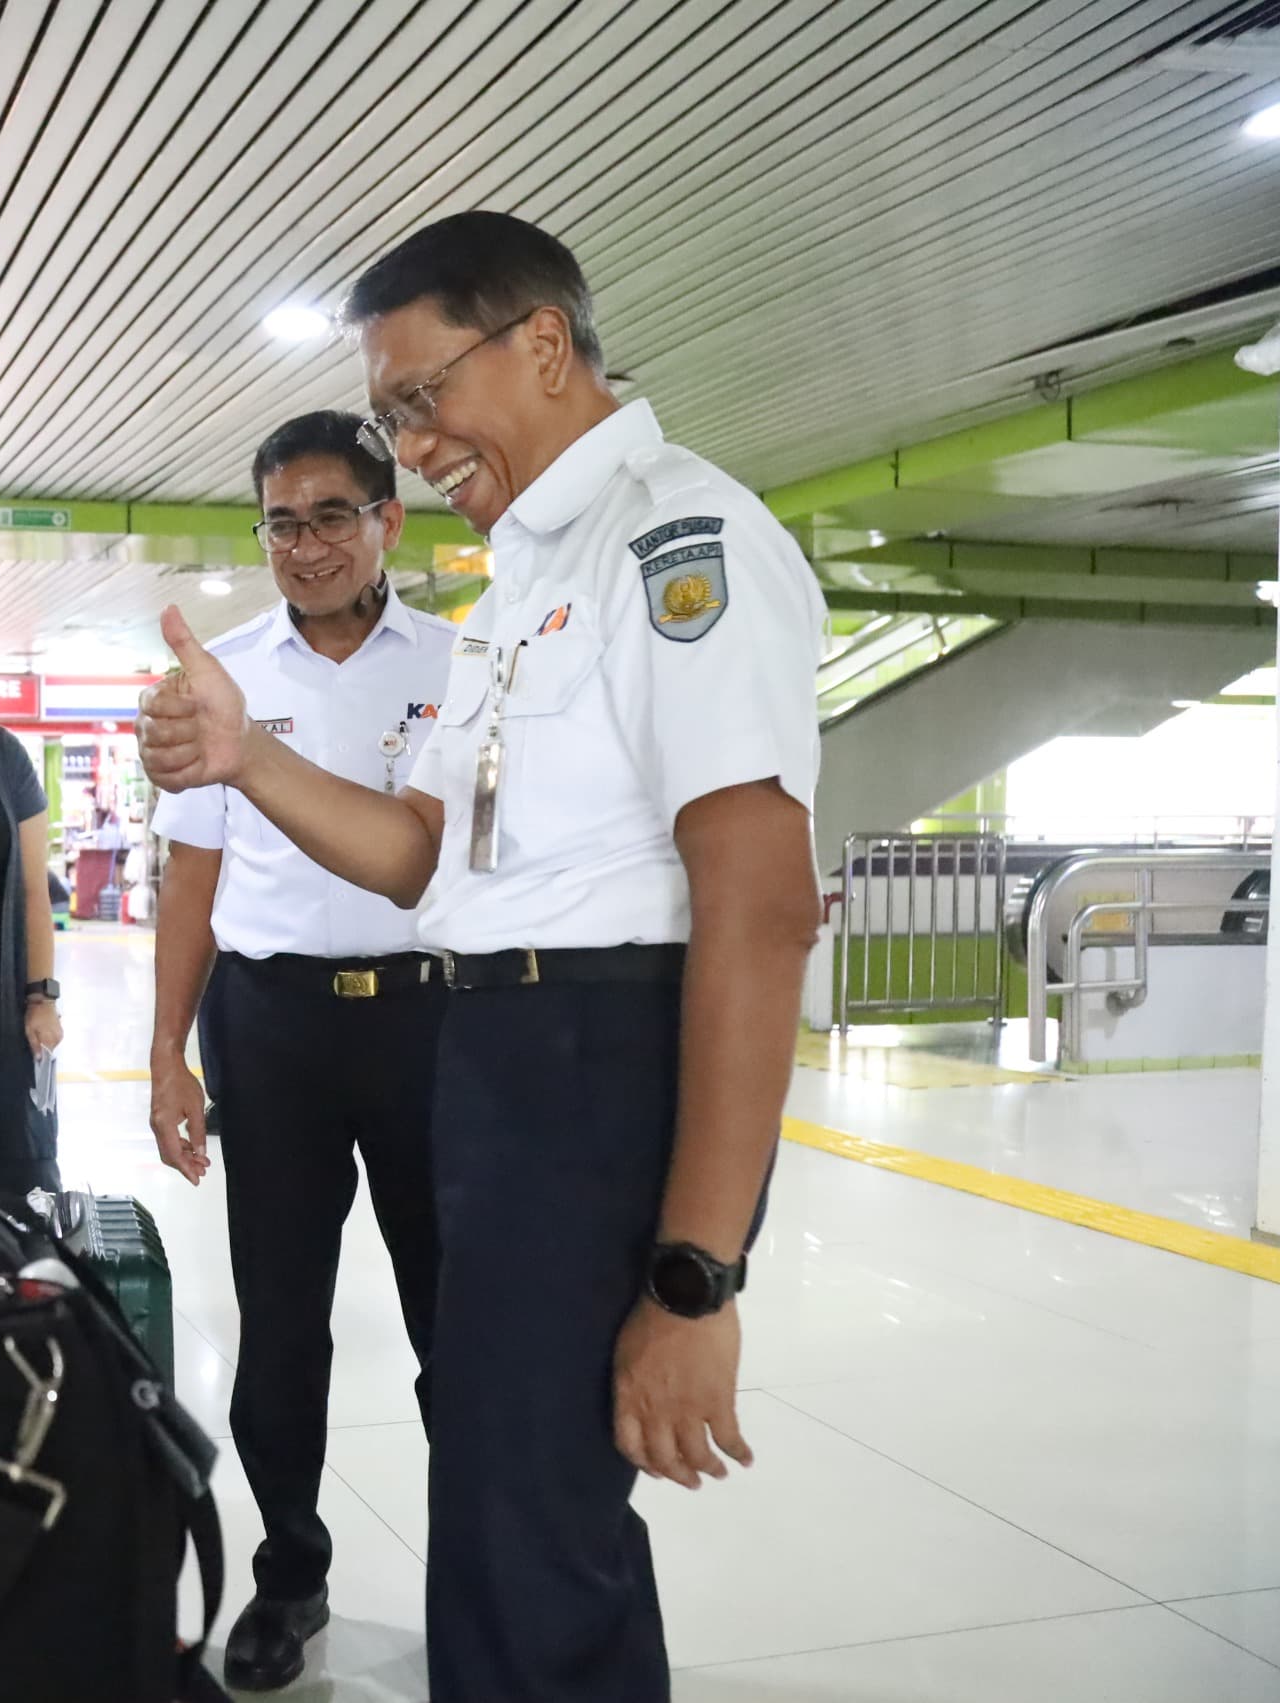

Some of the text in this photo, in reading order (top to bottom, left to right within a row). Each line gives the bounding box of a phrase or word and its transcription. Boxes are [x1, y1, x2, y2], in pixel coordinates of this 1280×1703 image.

[635, 522, 678, 554] KANTOR
[645, 545, 720, 573] KERETA API
[407, 703, 442, 719] KA
